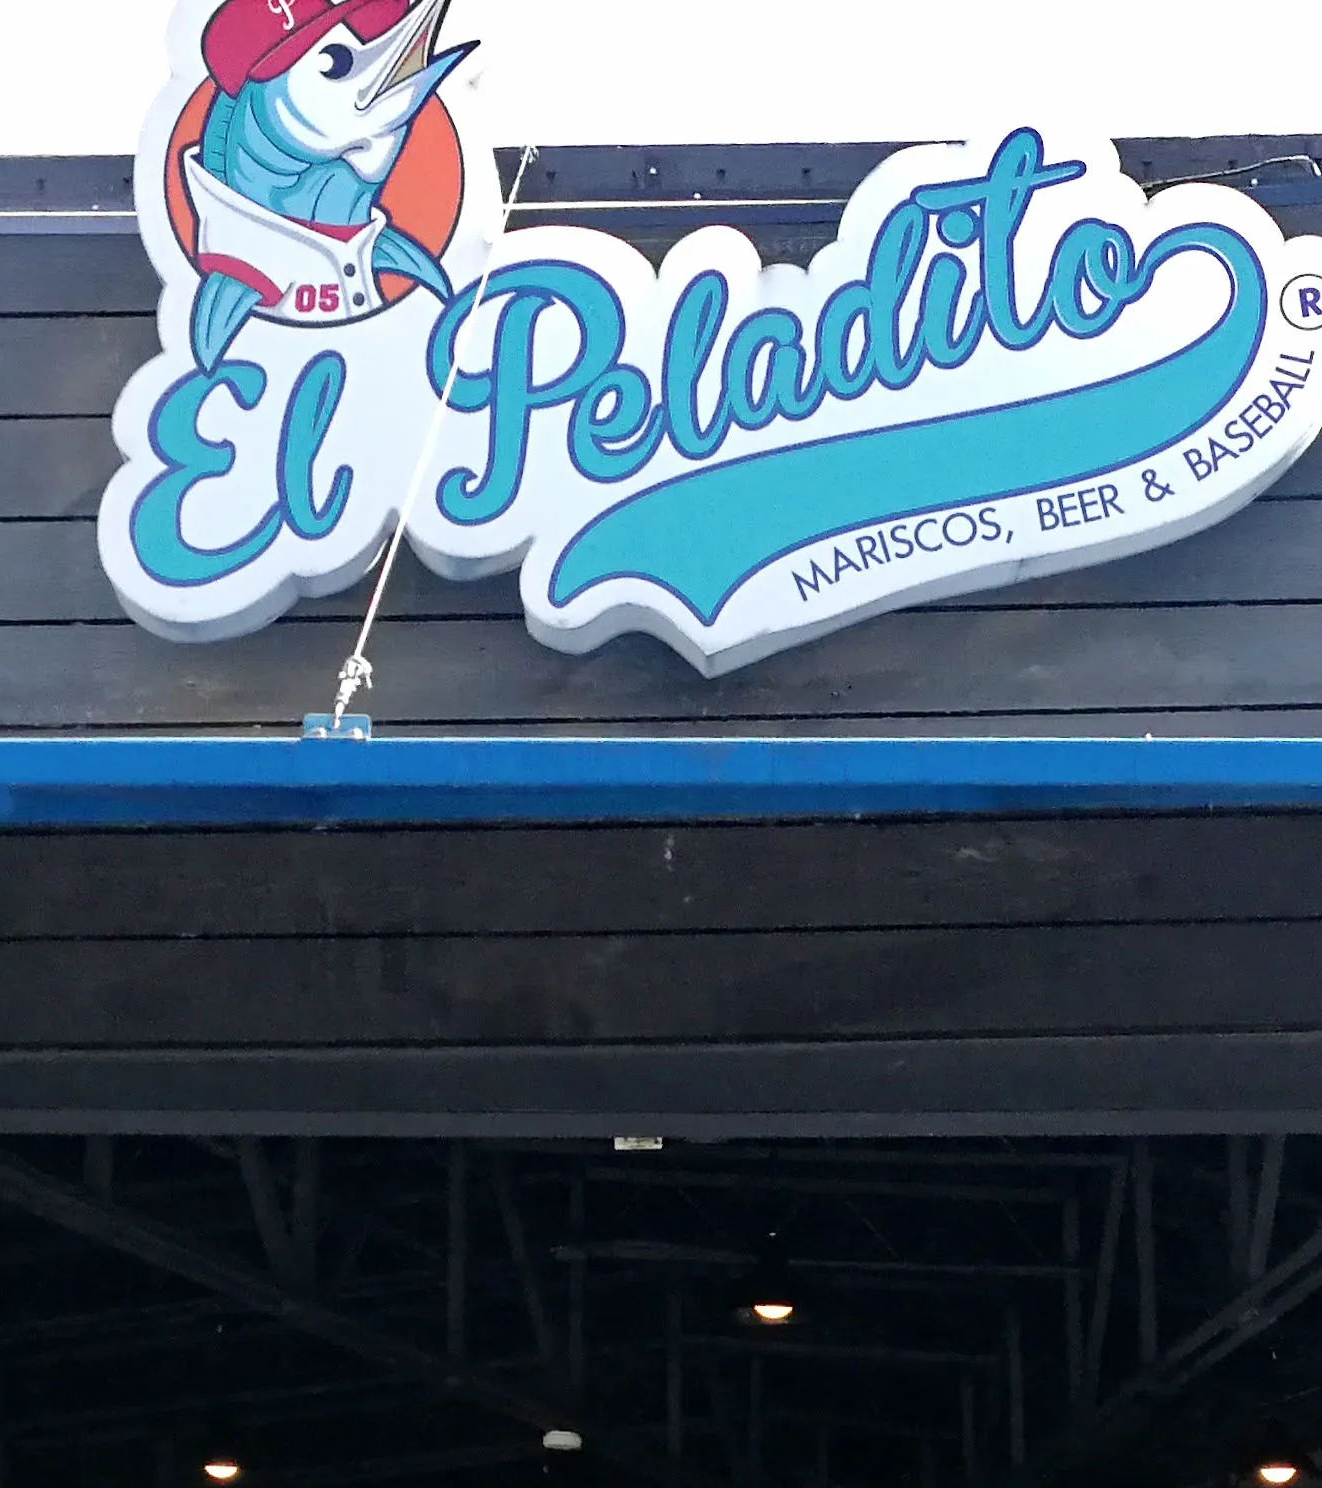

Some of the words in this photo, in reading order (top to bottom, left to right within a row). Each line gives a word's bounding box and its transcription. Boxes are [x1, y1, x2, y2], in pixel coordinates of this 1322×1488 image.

[130, 350, 353, 586] El
[427, 127, 1149, 526] Peladito
[294, 283, 340, 315] 05
[791, 500, 1015, 604] MARISCOS,
[1036, 482, 1125, 534] BEER
[1141, 466, 1171, 504] &
[1185, 347, 1318, 484] BASEBALL
